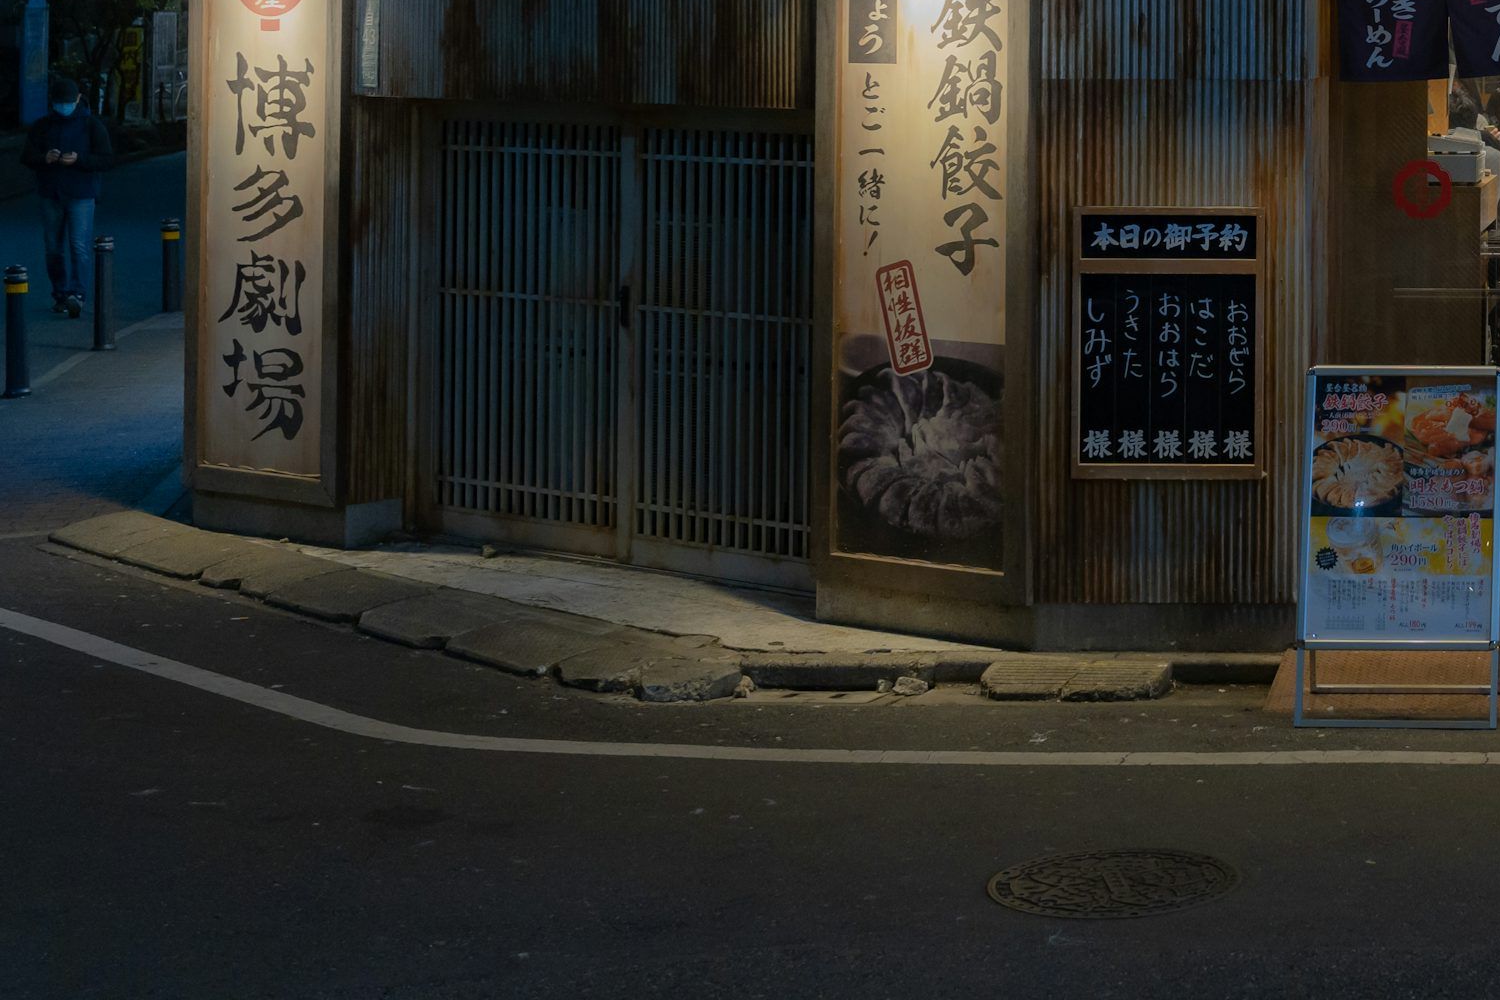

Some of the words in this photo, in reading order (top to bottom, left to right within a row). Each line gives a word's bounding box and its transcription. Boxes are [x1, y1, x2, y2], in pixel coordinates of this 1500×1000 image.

[217, 52, 315, 442] 博多劇場
[1090, 222, 1249, 251] 本日の御予約
[884, 267, 926, 366] 相性抜群
[1084, 297, 1112, 389] しみず
[1122, 289, 1144, 380] うきた
[1158, 292, 1182, 398] おおはら
[1189, 297, 1216, 380] はこだ
[1082, 429, 1113, 460] 様
[1117, 429, 1148, 460] 様
[1152, 429, 1184, 460] 様
[1187, 429, 1219, 460] 様
[1222, 429, 1254, 460] 様
